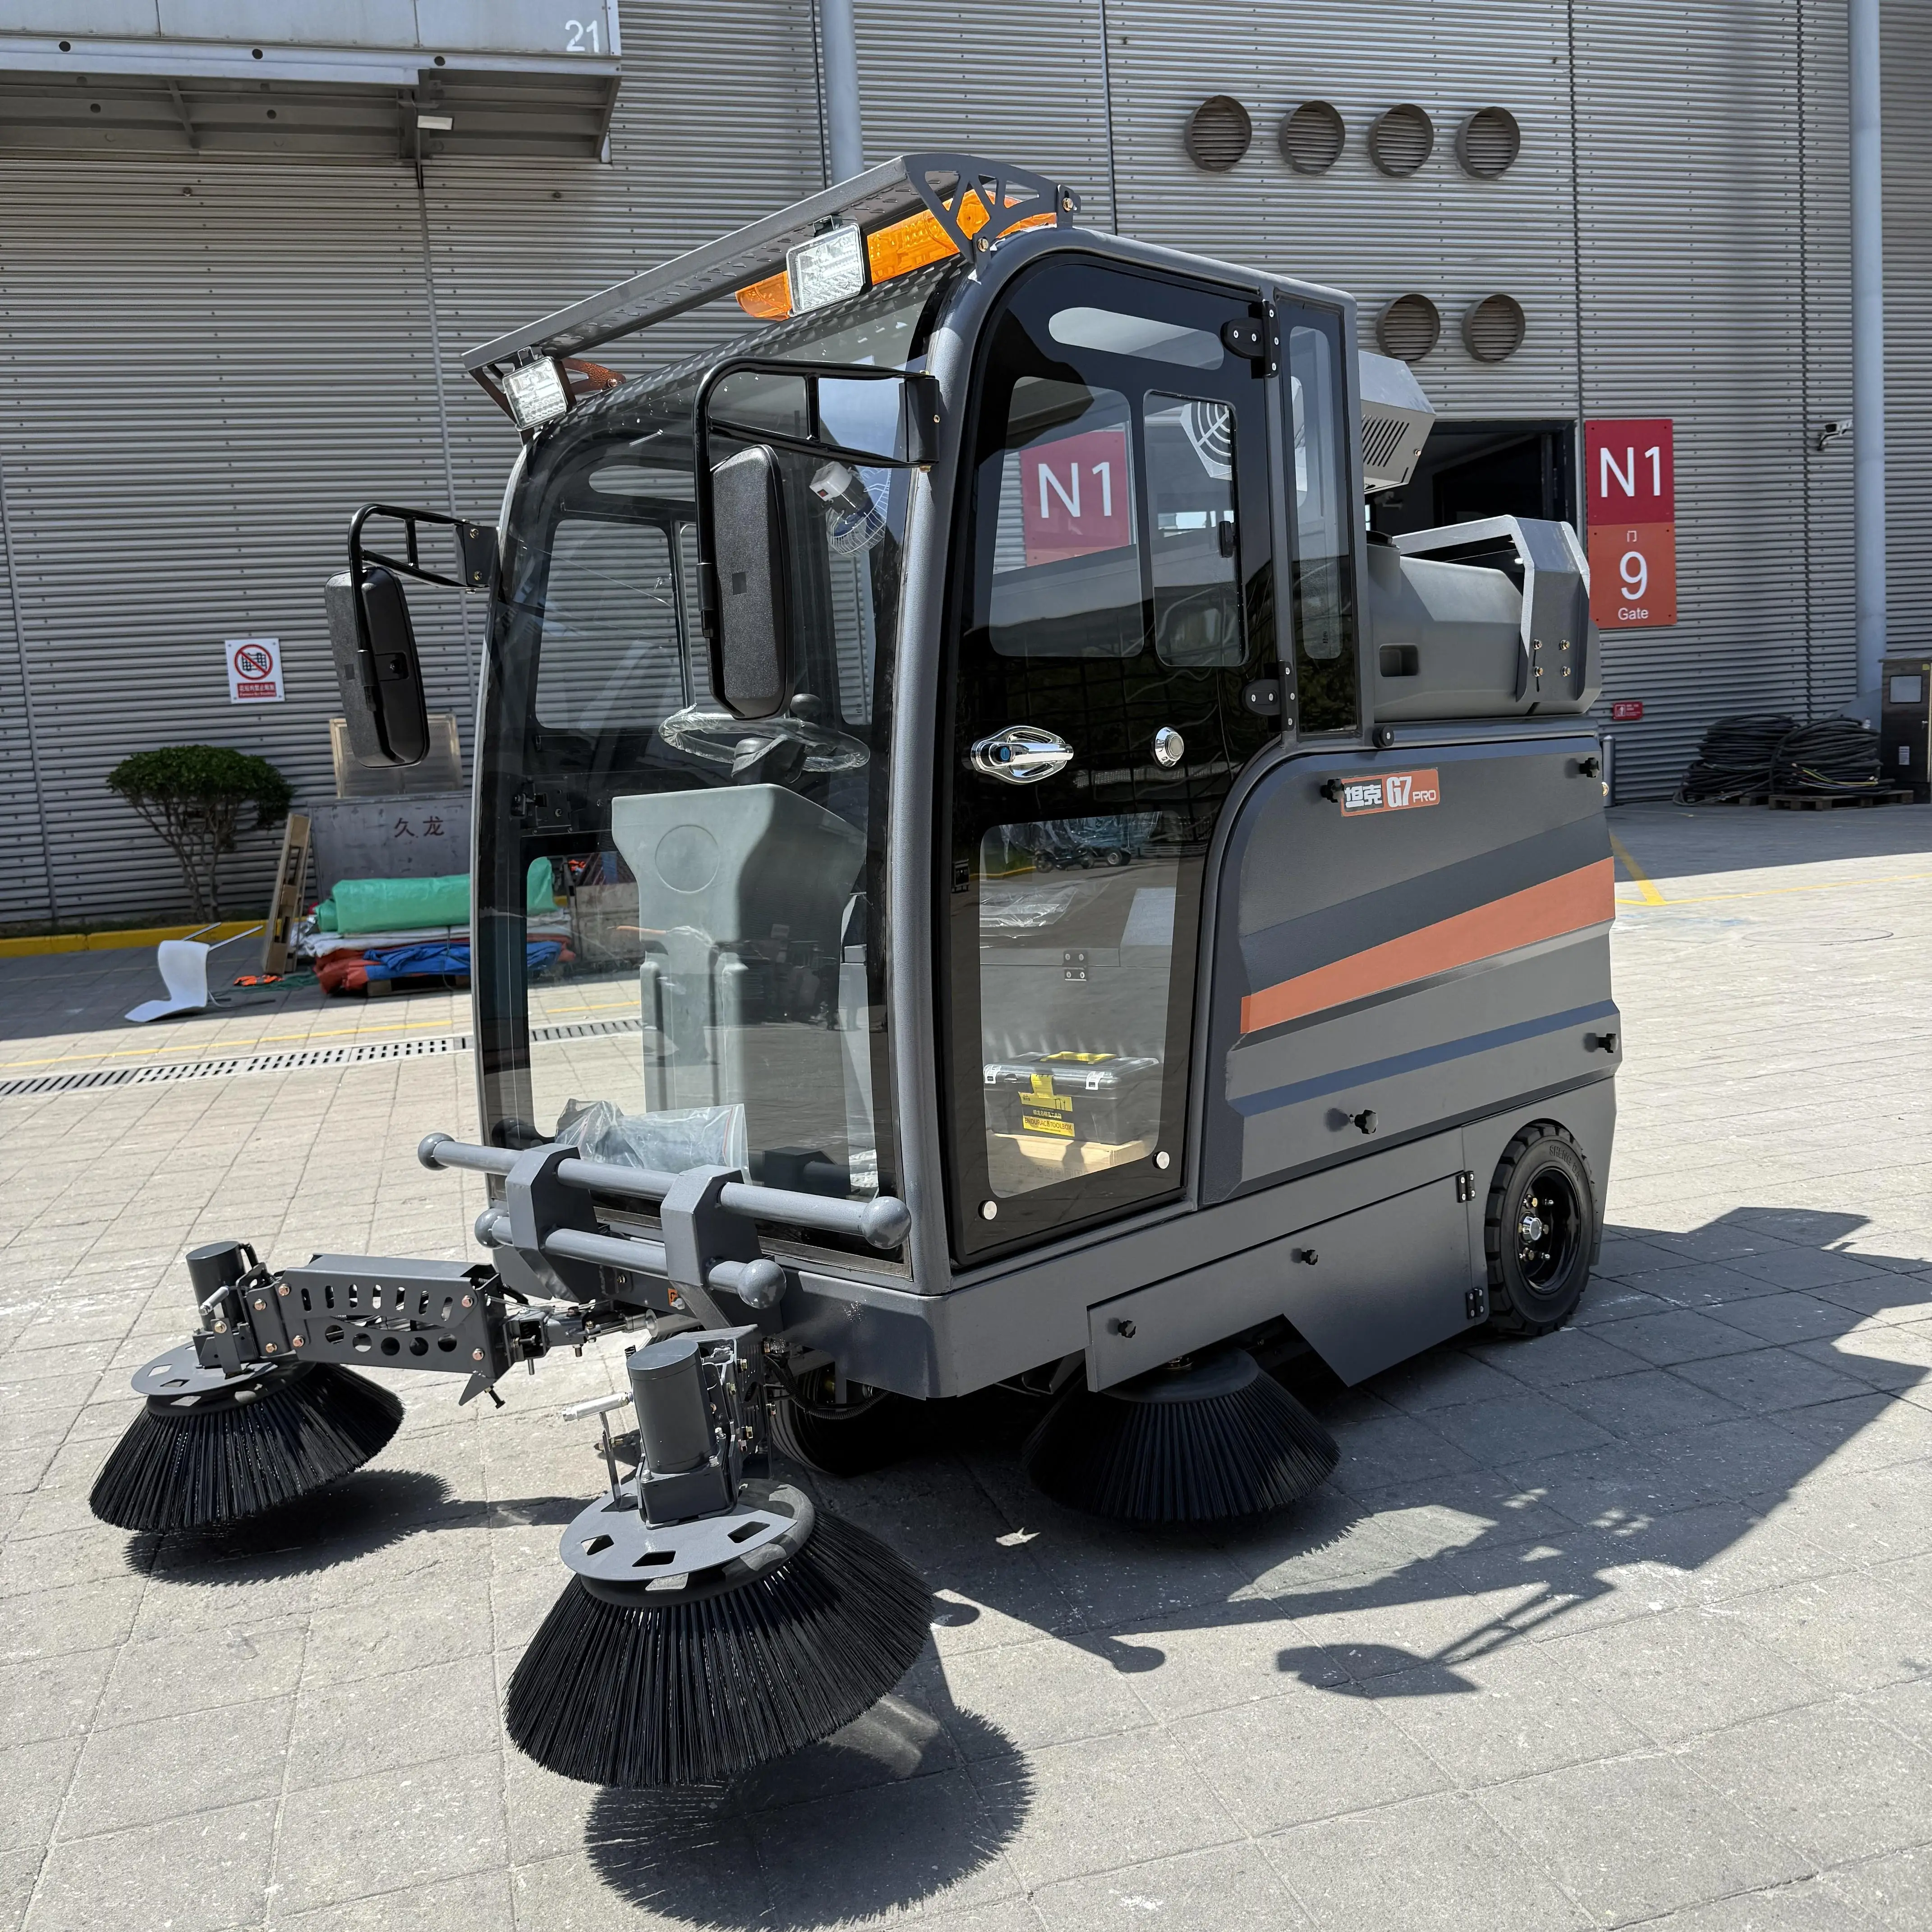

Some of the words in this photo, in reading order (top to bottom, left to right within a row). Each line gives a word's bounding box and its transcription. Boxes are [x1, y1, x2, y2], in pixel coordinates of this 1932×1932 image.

[565, 20, 599, 53] 21
[1600, 446, 1661, 497] N1
[1038, 462, 1112, 518] N1
[1619, 551, 1647, 600] 9
[1618, 607, 1649, 621] Gate
[1344, 784, 1382, 808] 坦克
[1386, 776, 1412, 808] G7
[1412, 790, 1436, 803] PRO
[1050, 1121, 1072, 1131] TOOLBOX
[1550, 1145, 1572, 1166] SHENG
